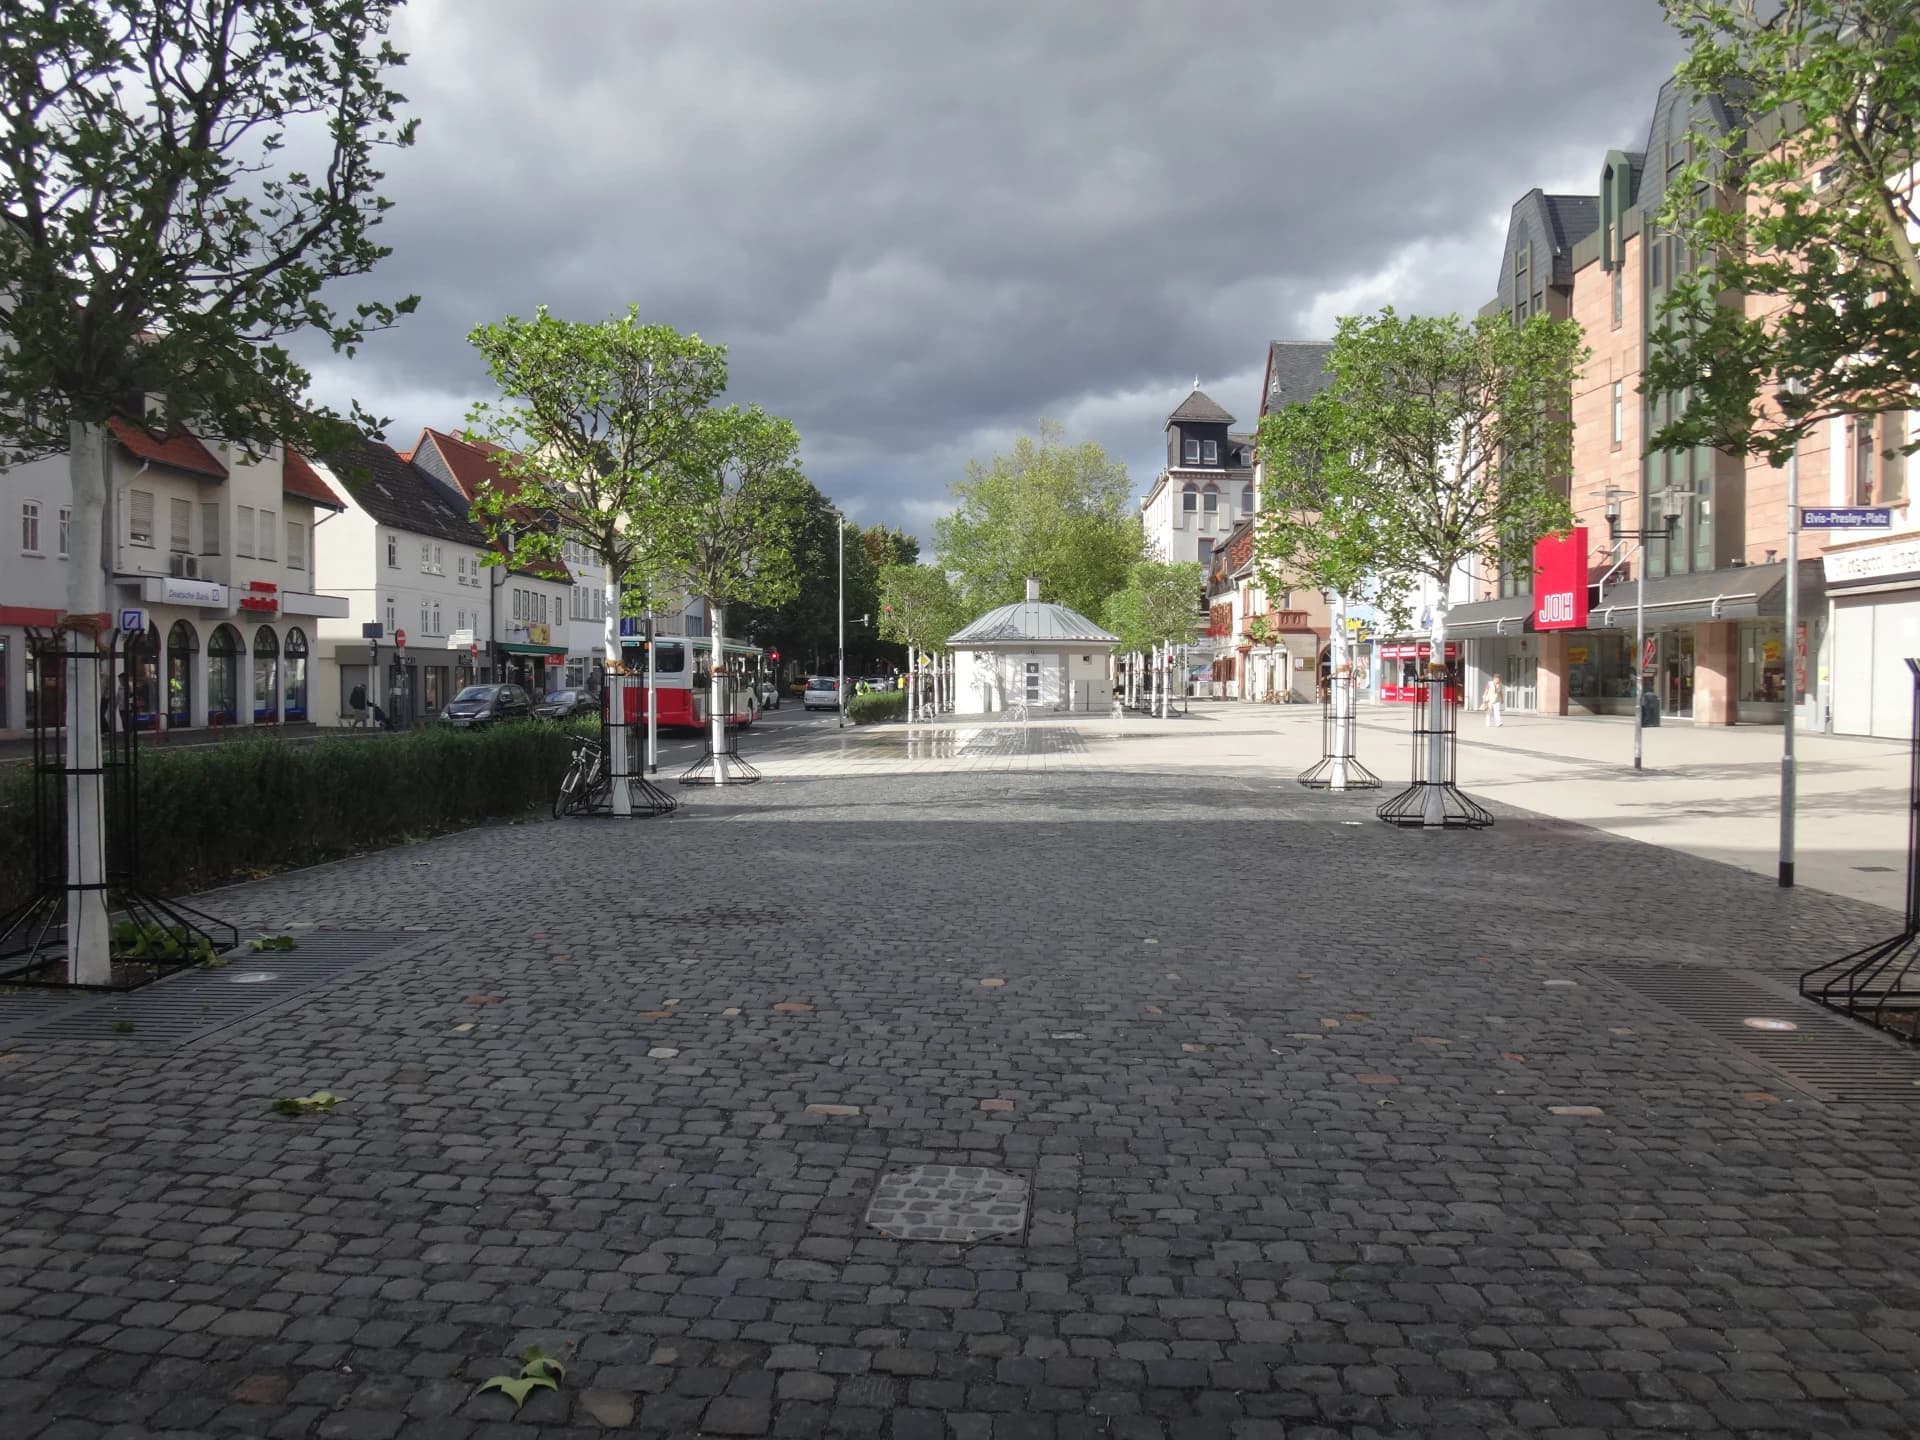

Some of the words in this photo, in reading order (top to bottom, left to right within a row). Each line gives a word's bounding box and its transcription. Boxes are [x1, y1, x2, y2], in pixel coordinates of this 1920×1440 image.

[1804, 512, 1888, 526] Elvis-Presley-Platz
[168, 589, 194, 599] Deutsche
[195, 591, 210, 601] Bank
[1538, 592, 1574, 623] JOH
